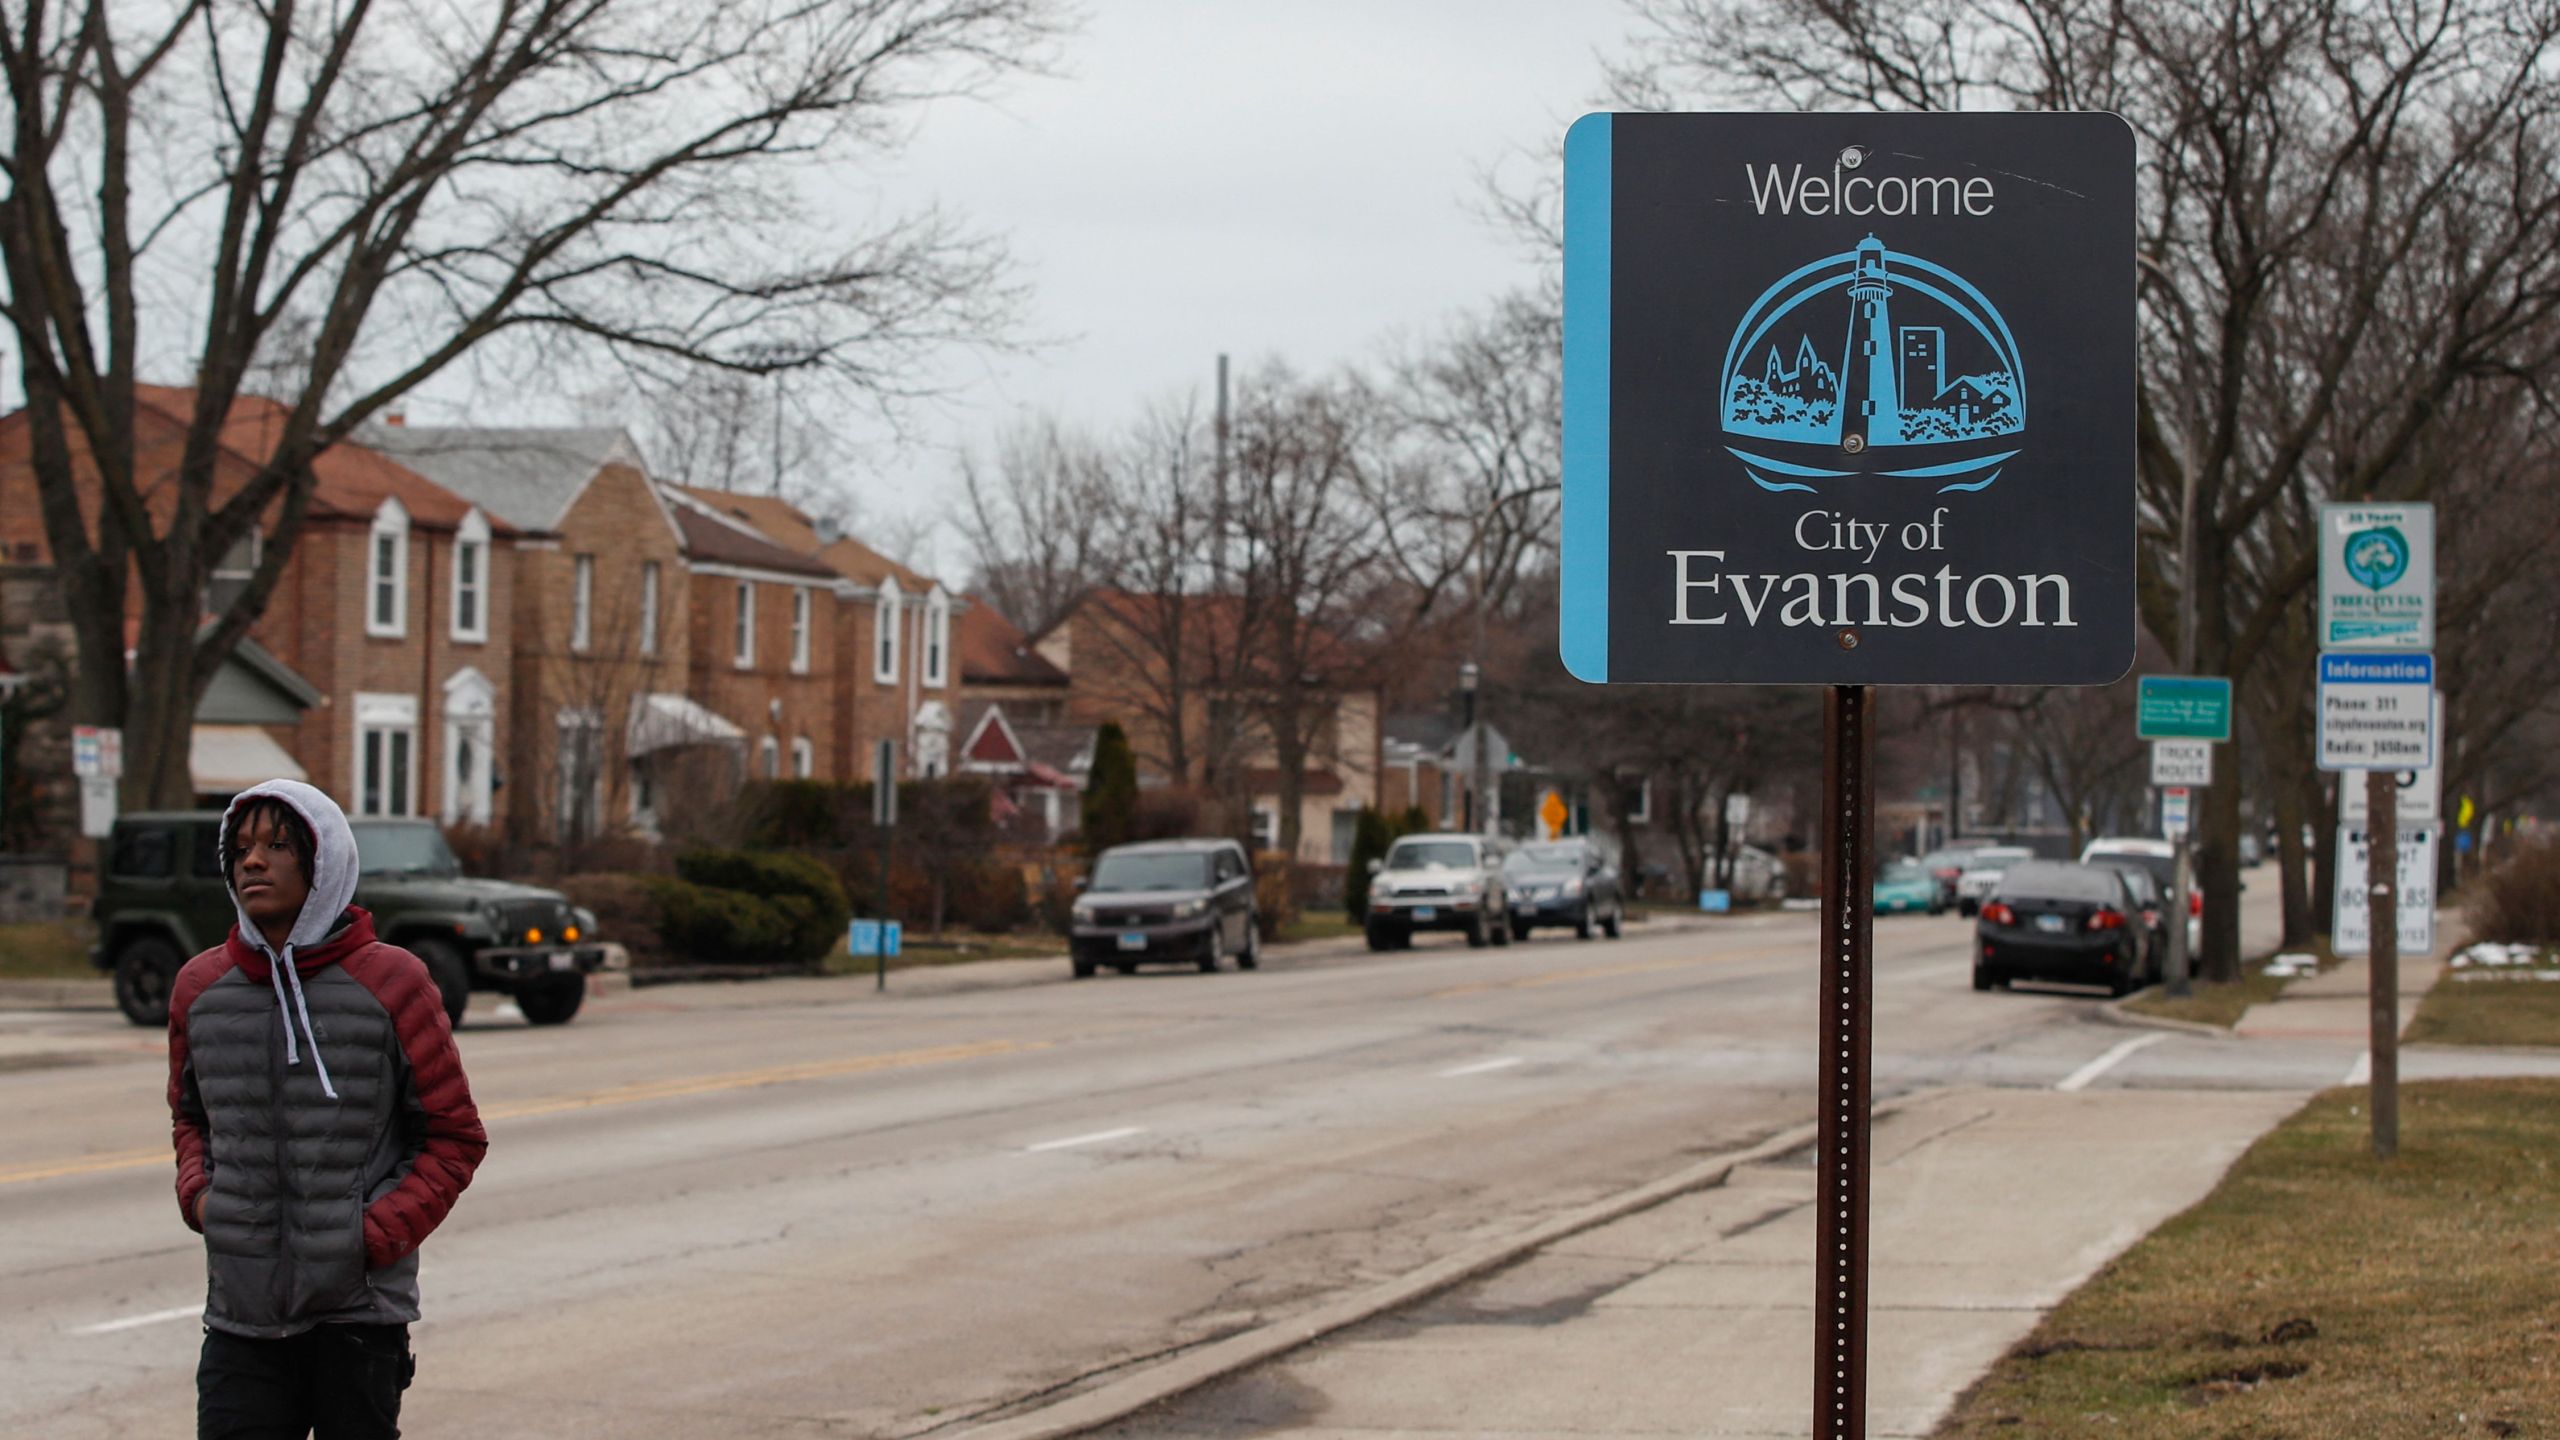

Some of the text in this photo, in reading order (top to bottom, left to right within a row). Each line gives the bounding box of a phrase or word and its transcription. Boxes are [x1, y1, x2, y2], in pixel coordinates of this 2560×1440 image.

[1746, 159, 1994, 215] Welcome
[2366, 512, 2403, 522] Years
[1795, 507, 1949, 563] City of
[1666, 549, 2078, 628] Evanston
[2333, 596, 2423, 606] TREE CITY USA
[2327, 660, 2427, 678] Information
[2376, 696, 2398, 710] 311
[2159, 746, 2204, 758] TRUCK
[2159, 764, 2204, 777] ROUTE
